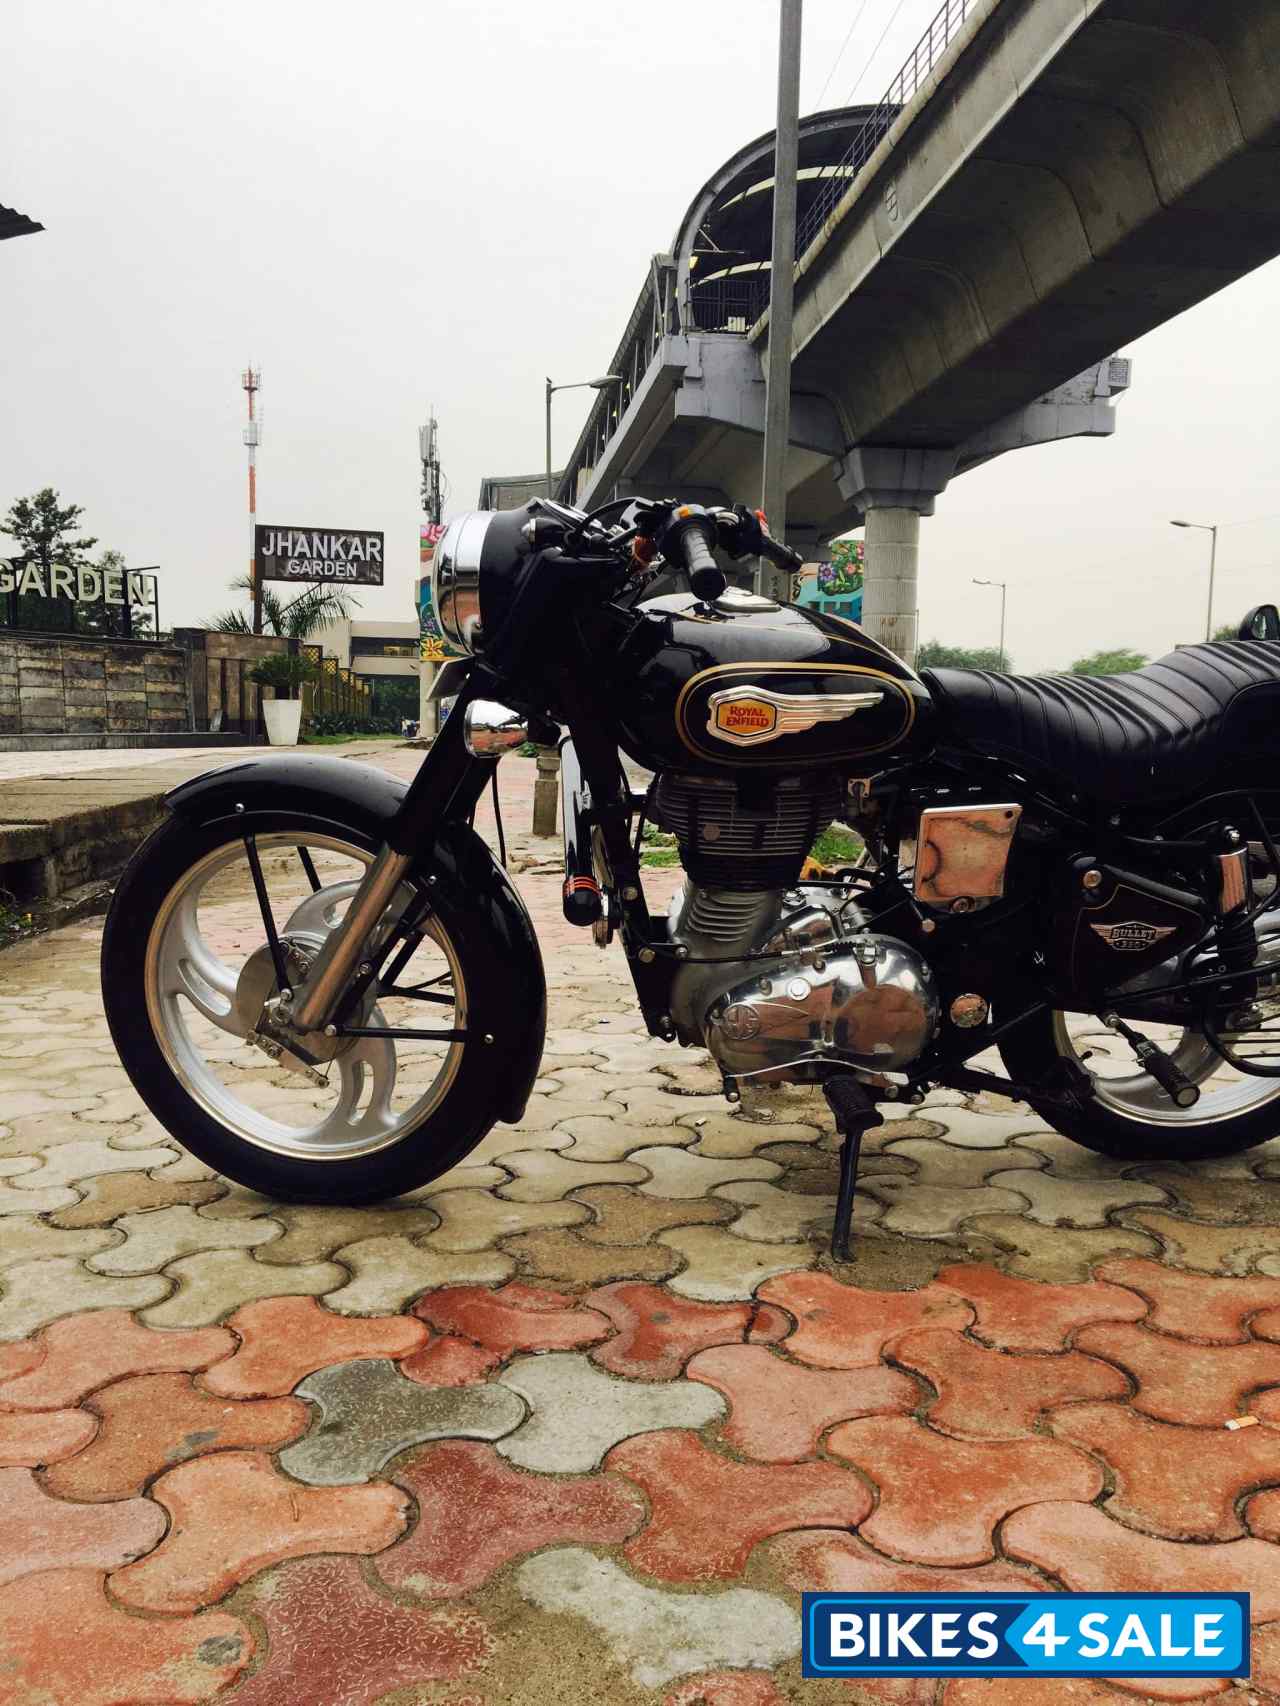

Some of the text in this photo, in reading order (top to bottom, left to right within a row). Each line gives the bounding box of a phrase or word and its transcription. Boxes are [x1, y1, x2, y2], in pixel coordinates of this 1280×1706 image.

[262, 530, 382, 562] JHANKAR
[288, 560, 357, 577] GARDEN
[0, 559, 152, 606] GARDEN
[730, 706, 765, 716] ROYAL
[726, 716, 769, 727] ENFIELD
[1111, 928, 1155, 939] BULLET
